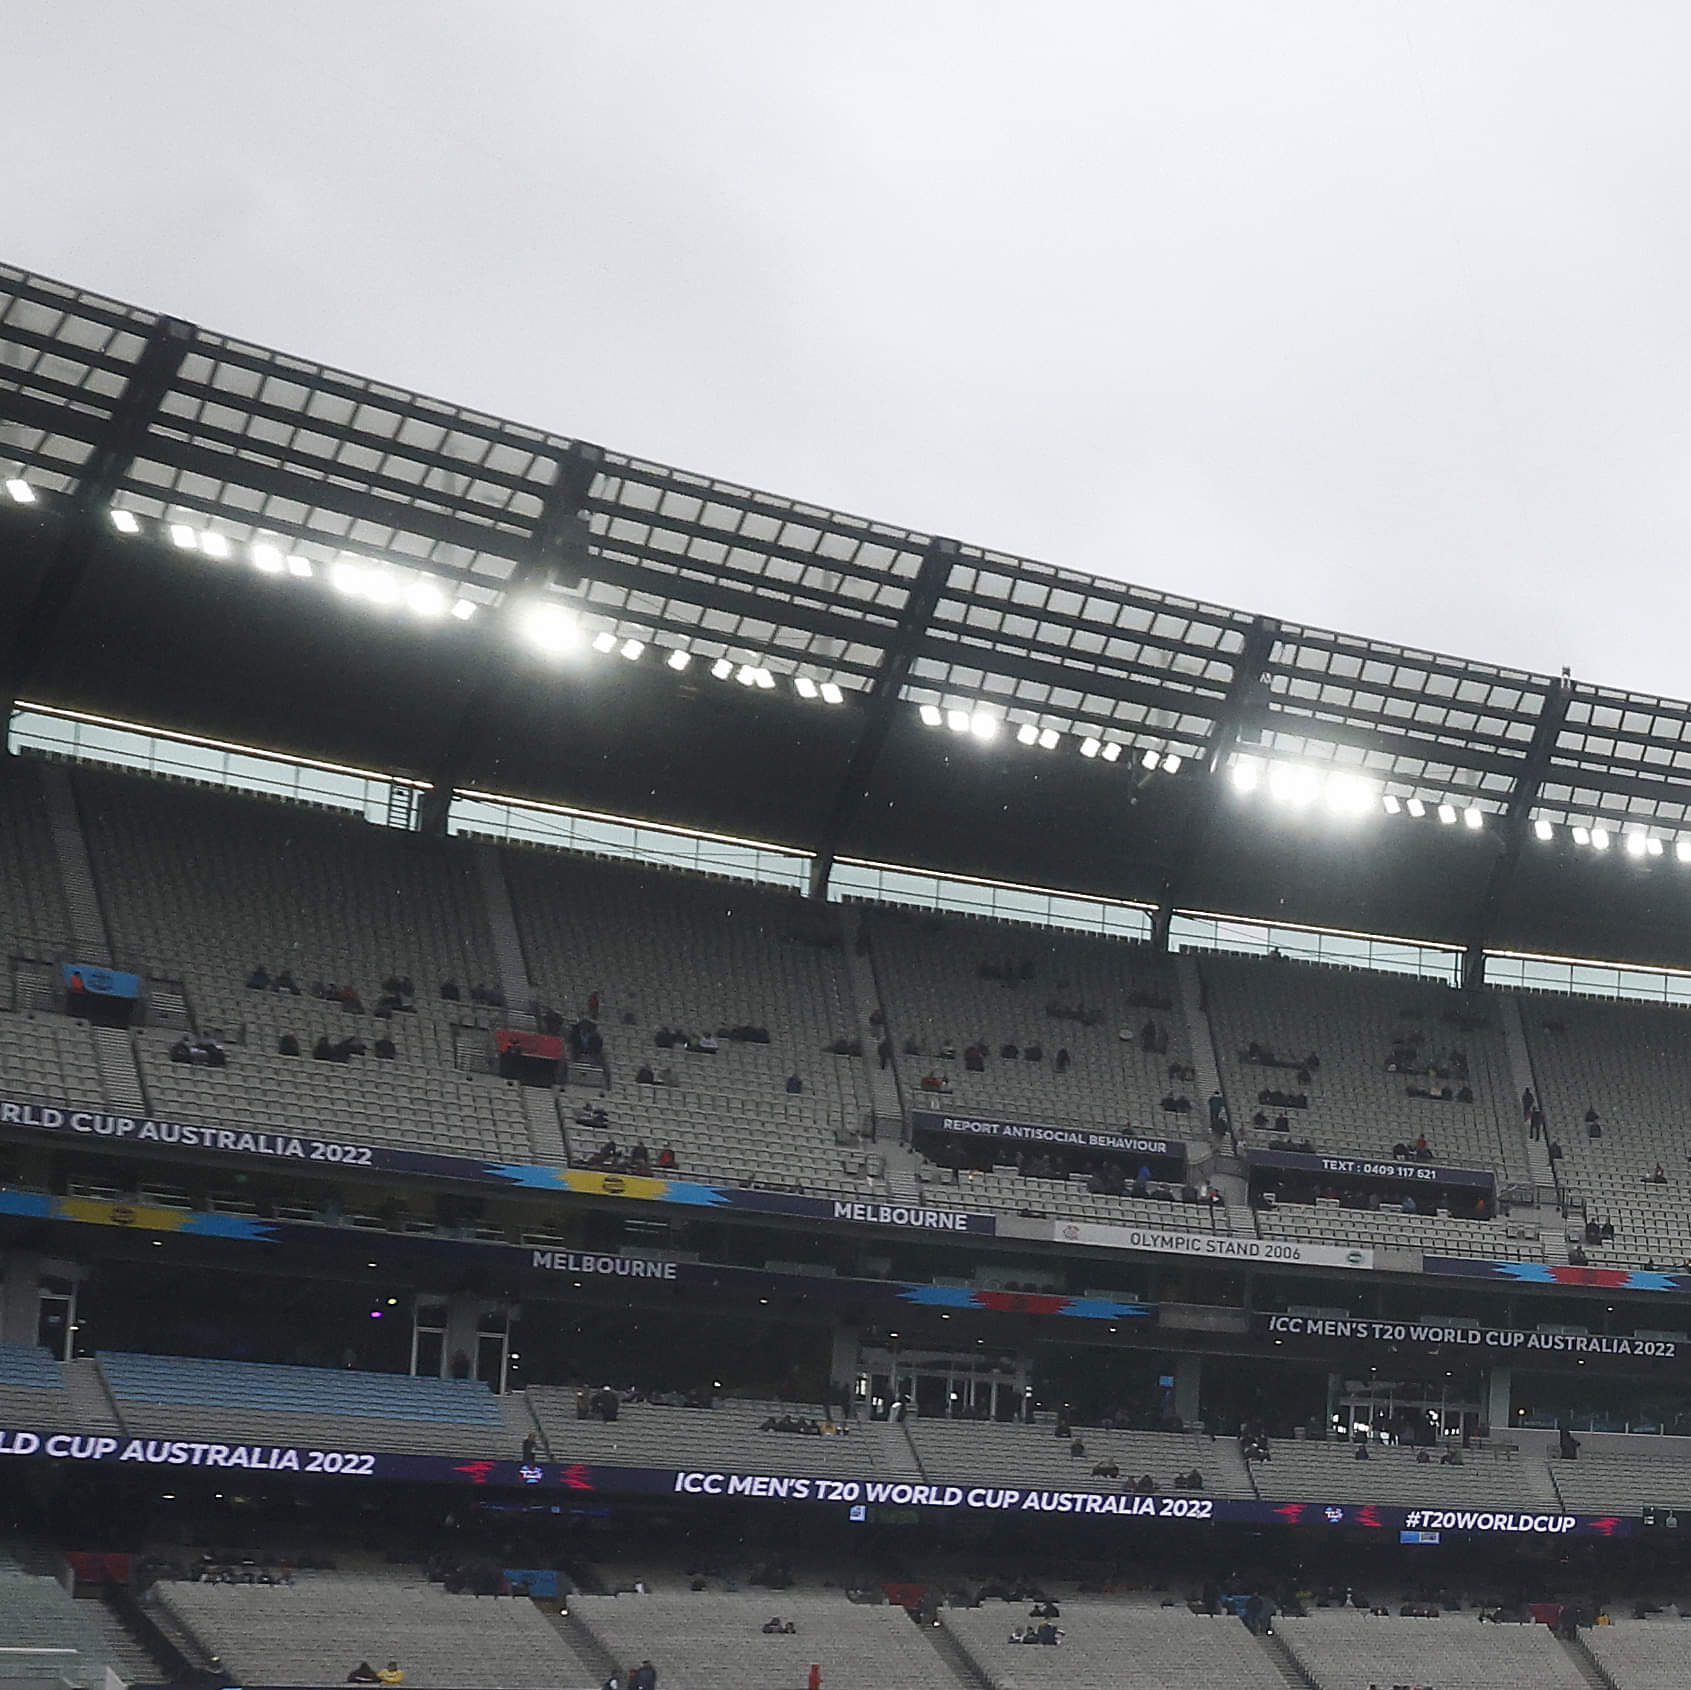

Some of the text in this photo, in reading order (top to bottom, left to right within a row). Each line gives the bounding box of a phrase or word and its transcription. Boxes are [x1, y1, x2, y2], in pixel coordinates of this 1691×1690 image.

[69, 1111, 135, 1138] CUP
[137, 1120, 305, 1157] AUSTRALIA
[310, 1140, 372, 1165] 2022
[943, 1118, 1167, 1153] REPORT ANTISOCIAL BEHAVIOUR
[1322, 1159, 1354, 1172] TEXT
[834, 1202, 967, 1230] MELBOURNE
[1130, 1232, 1301, 1260] OLYMPIC STAND 2006
[532, 1251, 676, 1279] MELBOURNE
[1268, 1315, 1675, 1356] ICC MEN'S T20 WORLD CUP AUSTRALIA 2022
[45, 1435, 117, 1460] CUP
[119, 1439, 299, 1470] AUSTRALIA
[304, 1450, 375, 1475] 2022
[673, 1472, 1213, 1518] ICC MEN'S T20 WORLD CUP AUSTRALIA 2022
[1405, 1510, 1576, 1533] #T20WORLDCUP
